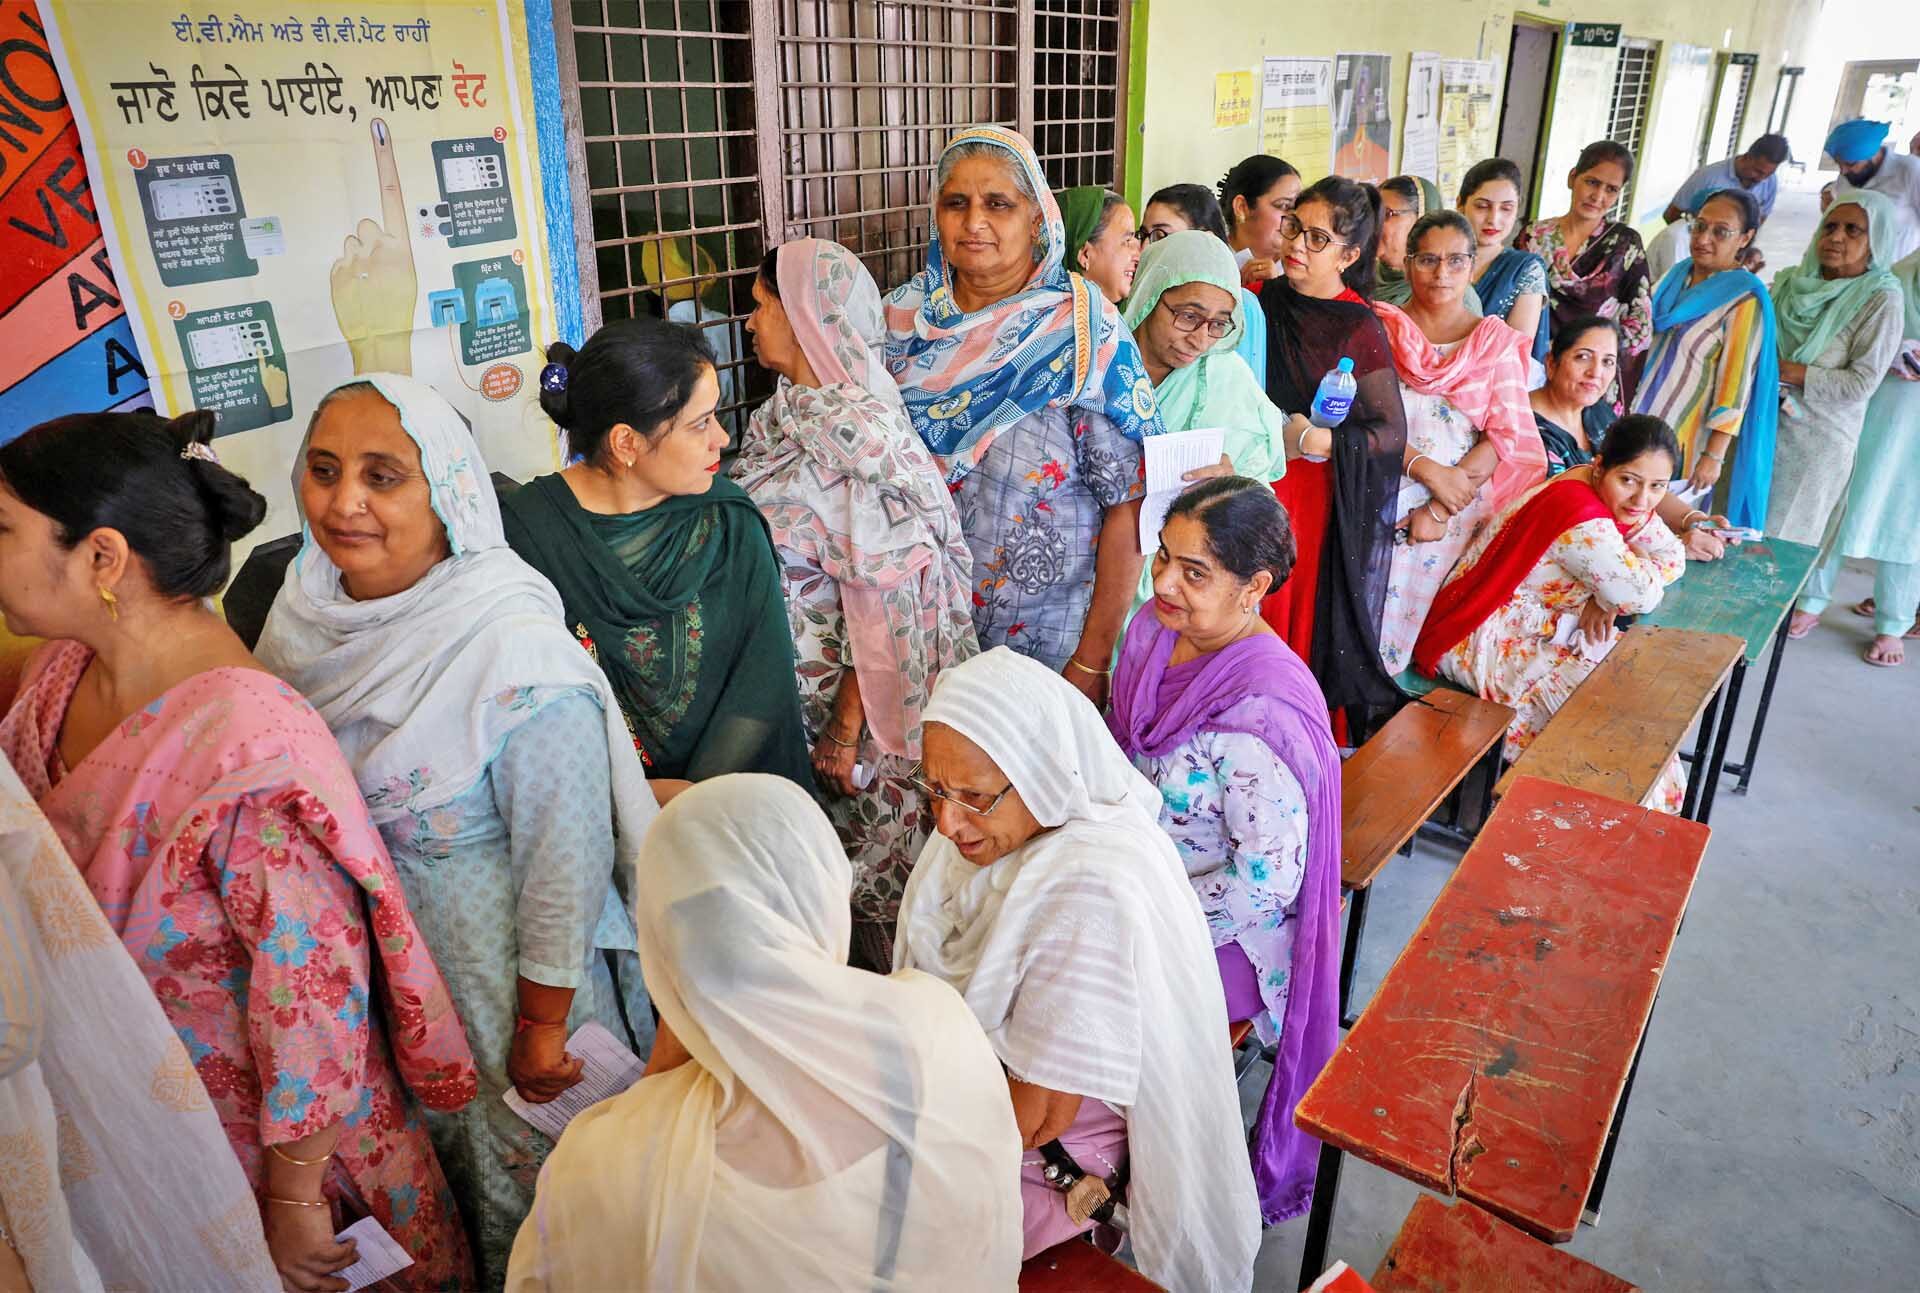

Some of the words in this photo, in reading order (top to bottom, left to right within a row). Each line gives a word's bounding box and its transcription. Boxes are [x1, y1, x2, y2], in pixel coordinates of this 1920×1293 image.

[171, 14, 264, 43] ਈ.ਵੀ.ਐਮ
[271, 16, 304, 42] ਅਤੇ
[311, 16, 386, 43] ਵੀ.ਵੀ.ਪੈਟ
[393, 18, 431, 43] ਰਾਹੀਂ
[110, 61, 179, 124] ਜਾਣੋ
[261, 62, 357, 123] ਪਾਈਏ,
[365, 75, 443, 112] ਆਪਣਾ
[451, 58, 487, 108] ਵੋਟ
[494, 127, 504, 140] 3
[131, 150, 141, 164] 1
[8, 143, 99, 249] VE
[171, 303, 182, 317] 2
